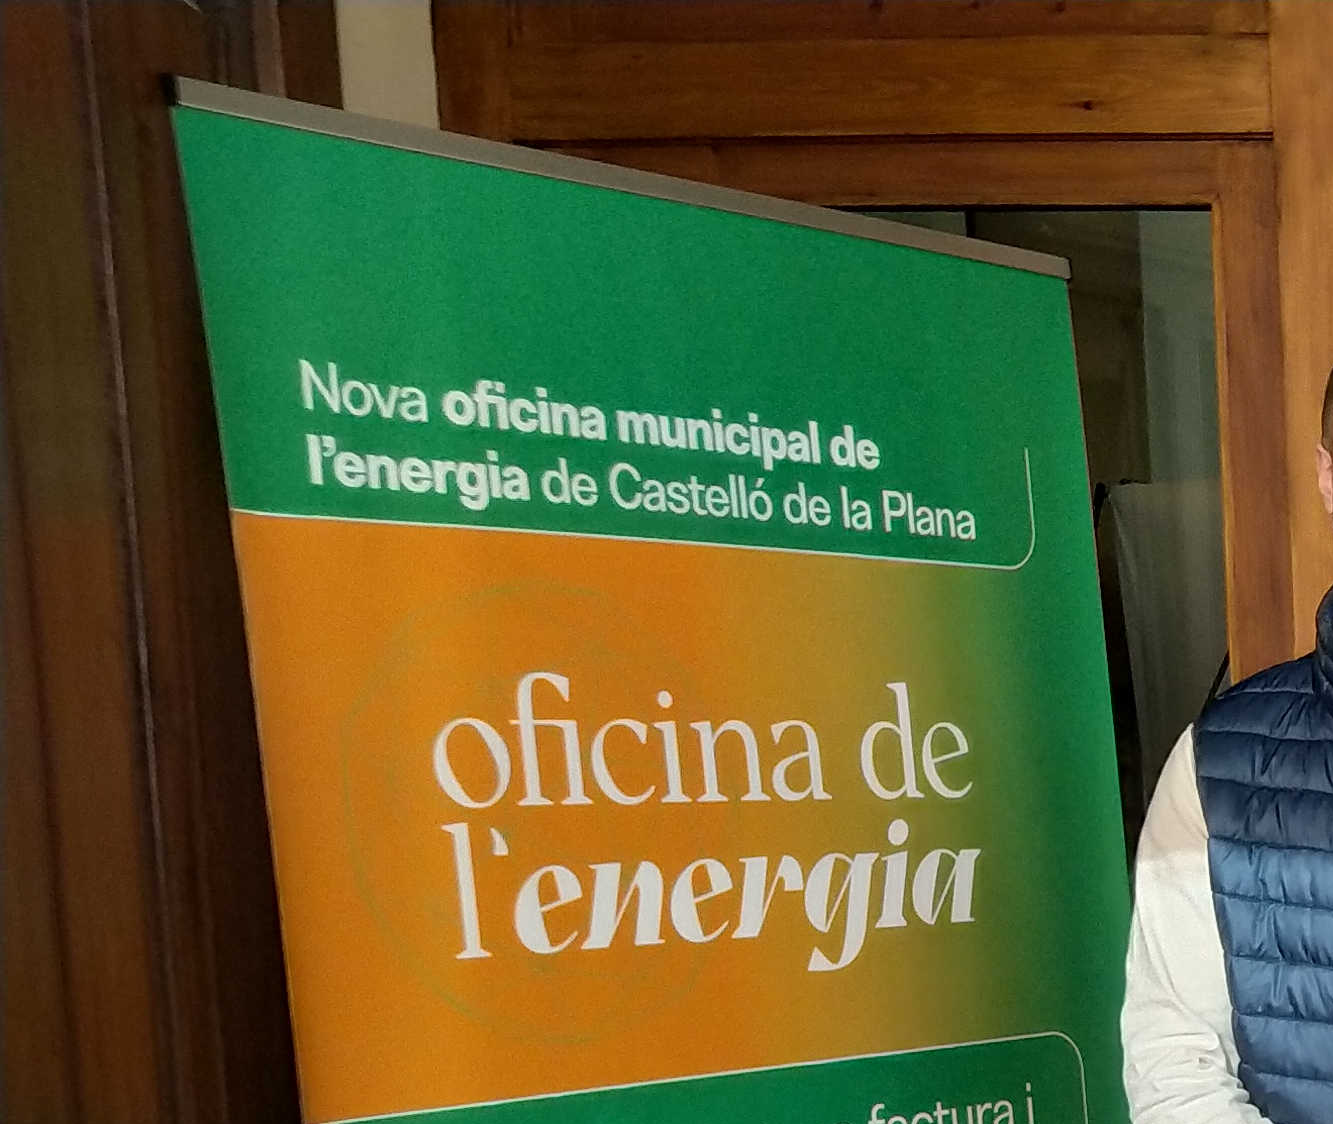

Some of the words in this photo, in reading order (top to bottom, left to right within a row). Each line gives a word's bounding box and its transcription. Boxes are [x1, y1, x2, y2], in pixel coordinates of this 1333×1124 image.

[298, 359, 429, 423] Nova
[441, 379, 607, 442] oficina
[617, 409, 820, 469] municipal
[829, 425, 881, 471] de
[305, 434, 531, 511] l'energia
[542, 455, 598, 506] de
[608, 463, 773, 524] Castelló
[784, 479, 832, 527] de
[841, 486, 874, 532] la
[882, 491, 977, 541] Plana
[433, 671, 833, 809] oficina
[860, 682, 974, 801] de
[441, 819, 982, 972] l'energia
